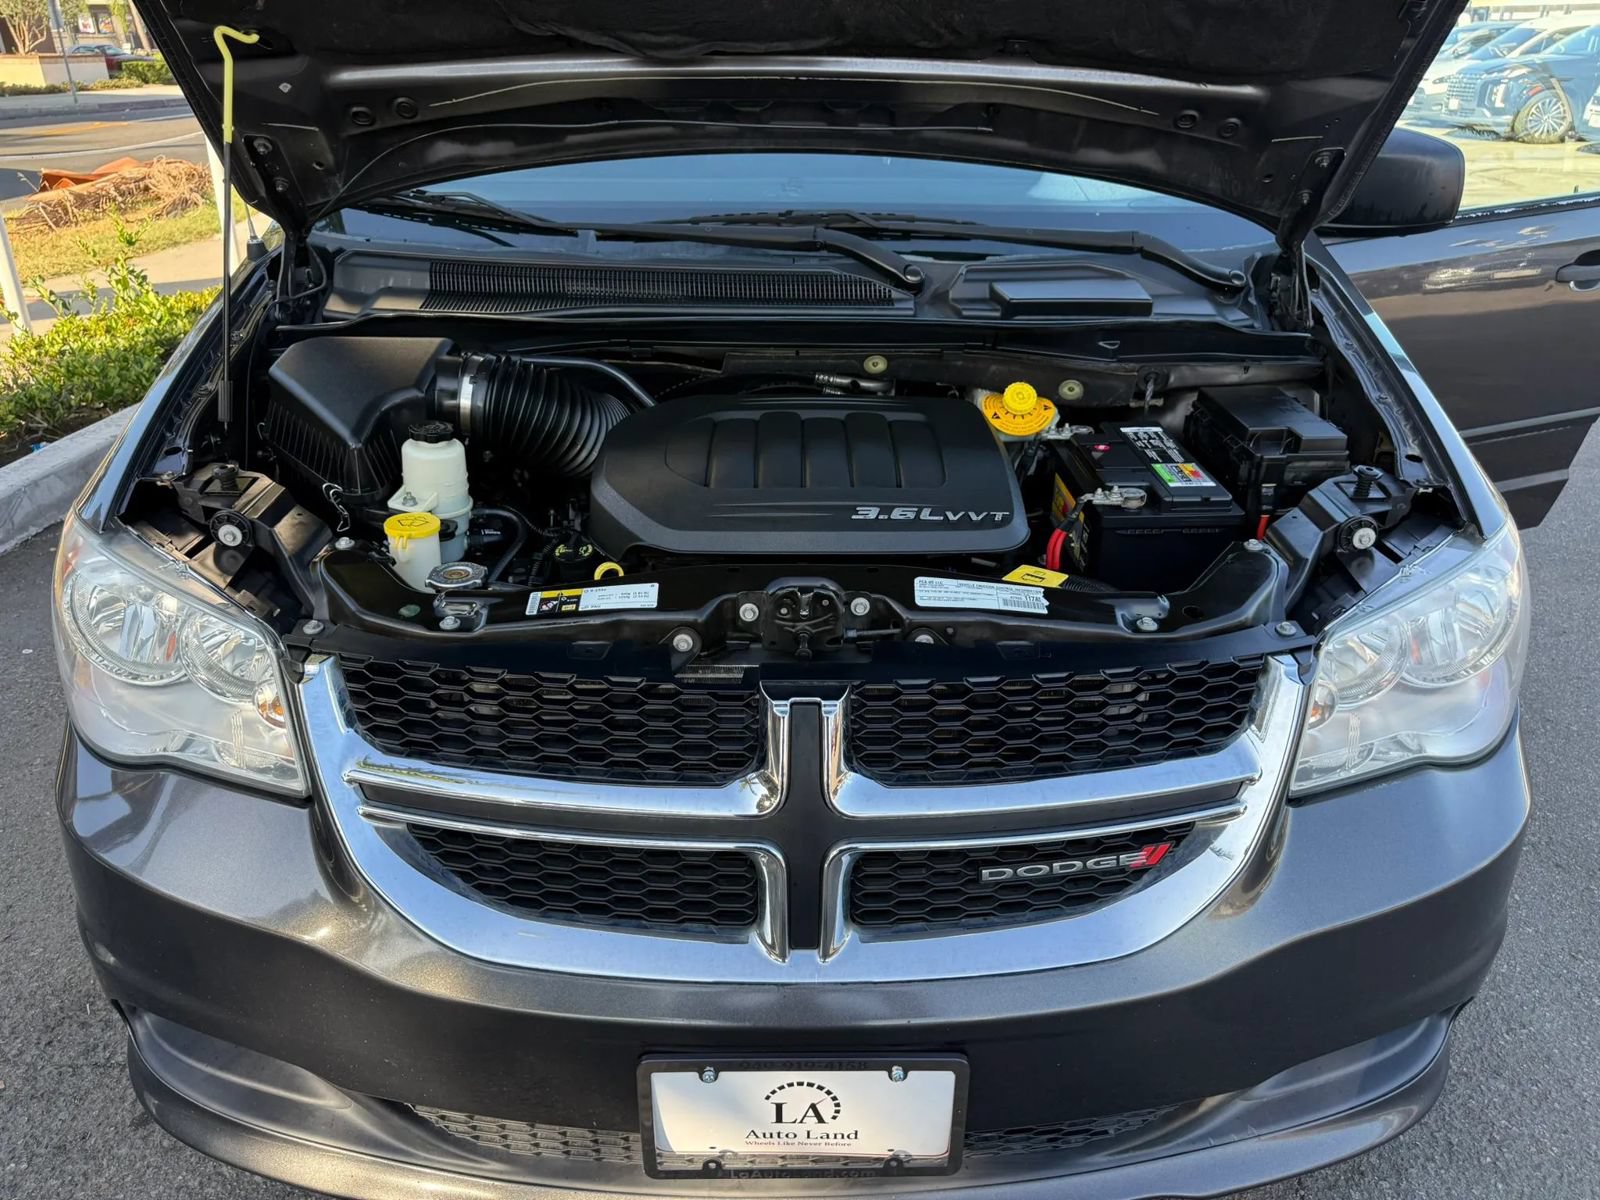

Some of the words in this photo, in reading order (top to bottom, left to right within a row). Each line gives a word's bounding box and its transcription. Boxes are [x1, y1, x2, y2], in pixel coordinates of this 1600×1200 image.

[851, 507, 944, 520] 3.6L
[982, 851, 1147, 881] DODGE
[770, 1102, 830, 1124] LA
[745, 1129, 798, 1139] Auto
[806, 1130, 859, 1140] Land
